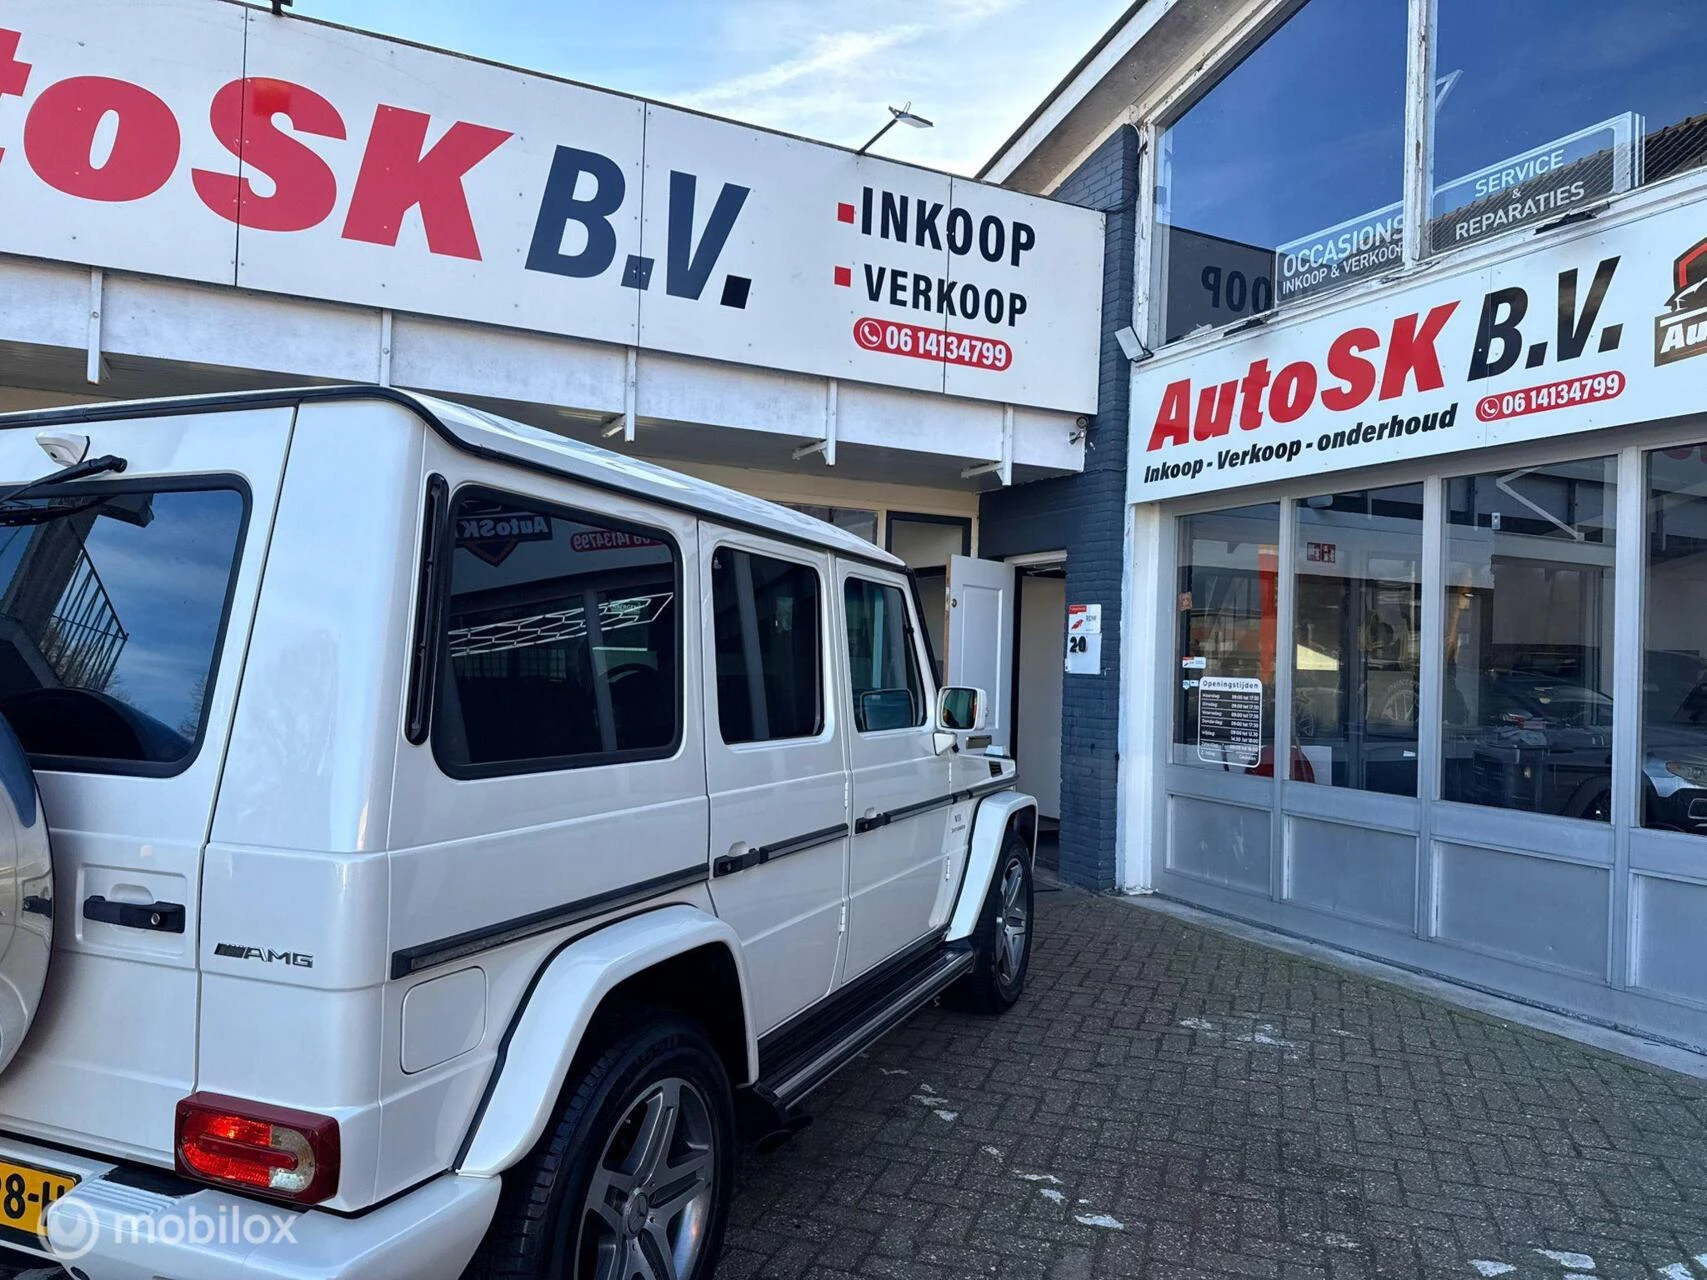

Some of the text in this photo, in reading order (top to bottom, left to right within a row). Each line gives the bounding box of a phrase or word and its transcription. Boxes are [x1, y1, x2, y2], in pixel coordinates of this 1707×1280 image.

[1475, 149, 1564, 197] SERVICE
[1512, 188, 1521, 198] &
[525, 145, 751, 309] B.V.
[861, 186, 1036, 267] INKOOP
[1455, 181, 1585, 240] REPARATIES
[864, 264, 1027, 327] VERKOOP
[1282, 267, 1327, 294] INKOOP
[1331, 265, 1340, 278] &
[885, 325, 1007, 367] 06 14134799
[1146, 255, 1624, 452] AutoSK B.V.
[1502, 374, 1620, 415] 06 14134799
[1144, 458, 1203, 484] Inkoop
[1217, 439, 1301, 470] Verkoop
[1317, 403, 1458, 451] onderhoud
[1070, 636, 1087, 653] 20
[1203, 680, 1259, 690] Openingstijden
[243, 947, 313, 968] AMG
